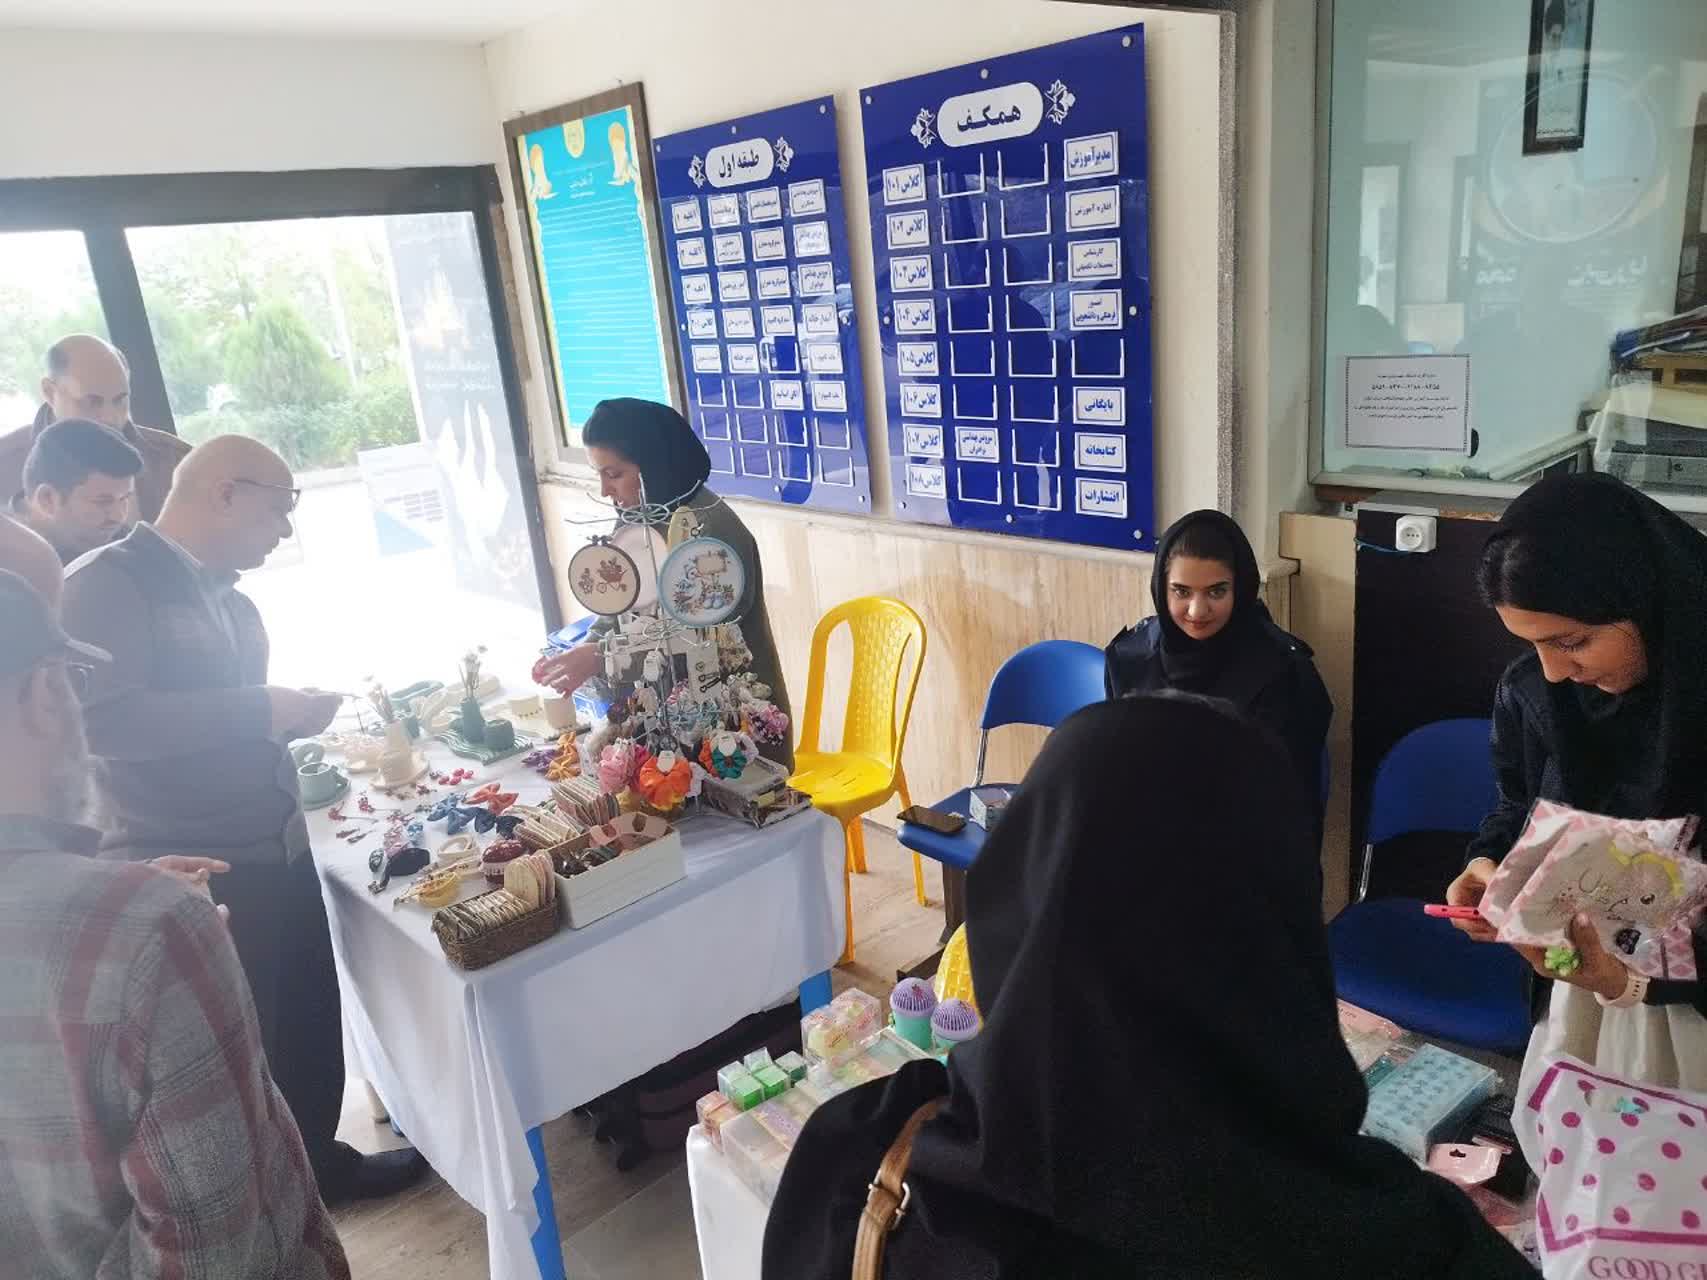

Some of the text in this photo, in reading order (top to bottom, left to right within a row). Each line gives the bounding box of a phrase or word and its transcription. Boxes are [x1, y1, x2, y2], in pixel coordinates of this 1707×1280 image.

[956, 104, 1022, 133] همکف
[718, 149, 760, 178] طبقه اول
[887, 174, 920, 193] کلاس ۱۰۱
[906, 218, 923, 236] کلاس
[908, 266, 927, 283] کلاس
[912, 308, 930, 325] کلاس
[915, 352, 933, 367] کلاس
[919, 393, 937, 408] کلاس
[1085, 398, 1114, 412] بایگانی
[920, 434, 939, 448] کلاس
[1085, 445, 1117, 458] کتابخانه
[923, 473, 941, 488] کلاس
[1085, 490, 1120, 504] انتشارات
[1588, 1256, 1671, 1280] GOOD
